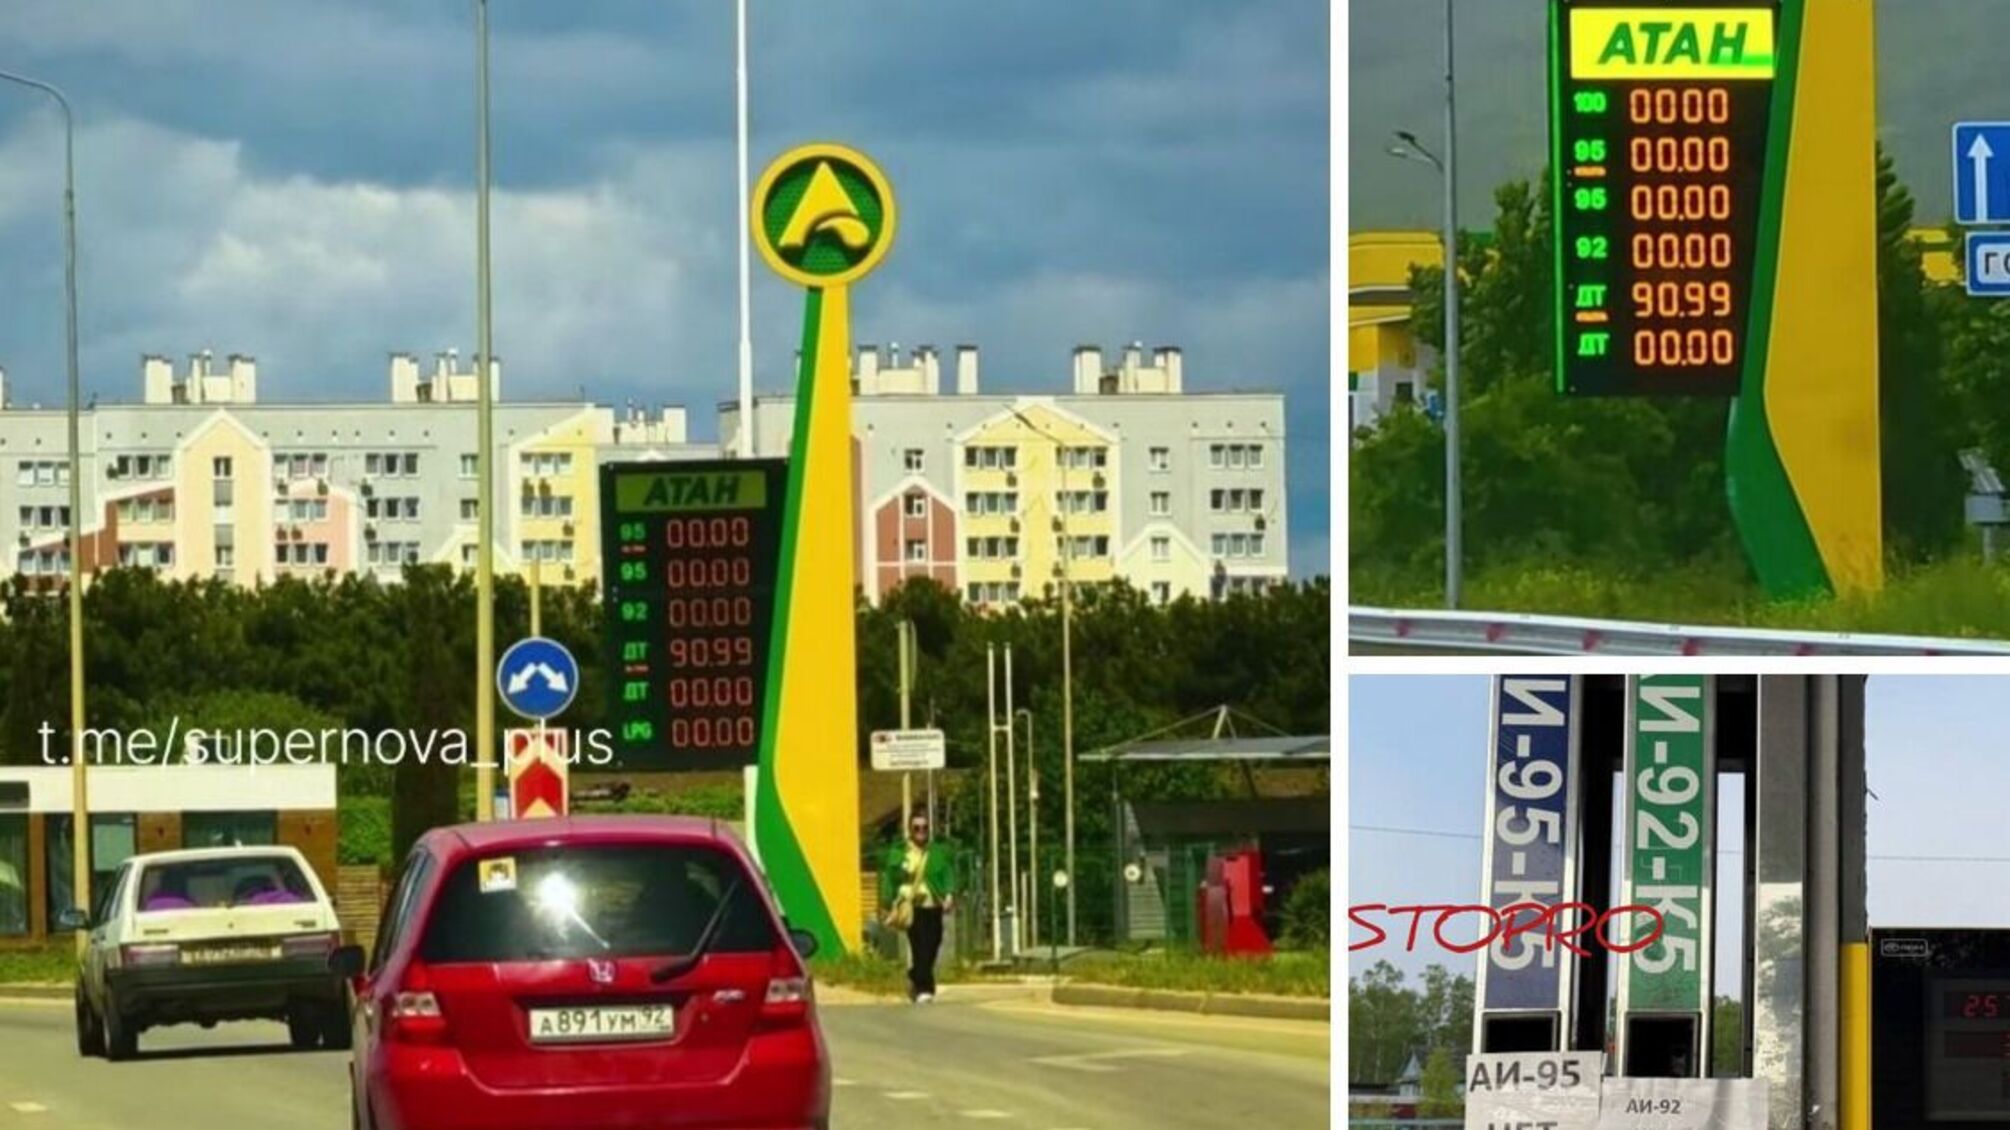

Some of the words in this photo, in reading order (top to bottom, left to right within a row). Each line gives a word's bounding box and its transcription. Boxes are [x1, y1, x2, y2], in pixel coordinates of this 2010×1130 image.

[1597, 22, 1748, 65] АТАН
[1574, 140, 1607, 162] 95
[1631, 137, 1729, 172] 00.00
[1575, 188, 1607, 210] 95
[1632, 185, 1730, 221] 00.00
[1575, 237, 1608, 258] 92
[1632, 233, 1731, 269] 00.00
[1575, 284, 1607, 307] ДТ
[1633, 282, 1731, 318] 90.99
[1578, 333, 1610, 356] ДТ
[1635, 330, 1733, 366] 00.00
[643, 476, 741, 506] АТАН
[620, 523, 646, 541] 95
[667, 517, 749, 548] 00.00
[620, 562, 647, 581] 95
[668, 558, 750, 588] 00.00
[621, 603, 648, 621] 92
[669, 597, 751, 628] 00.00
[623, 642, 648, 661] ДТ
[670, 637, 752, 667] 90.99
[624, 682, 649, 700] ДТ
[670, 677, 753, 708] 00.00
[622, 722, 653, 741] LPG
[672, 716, 755, 747] 00.00
[1469, 1059, 1581, 1093] АИ-95
[1625, 1099, 1680, 1115] АИ-92
